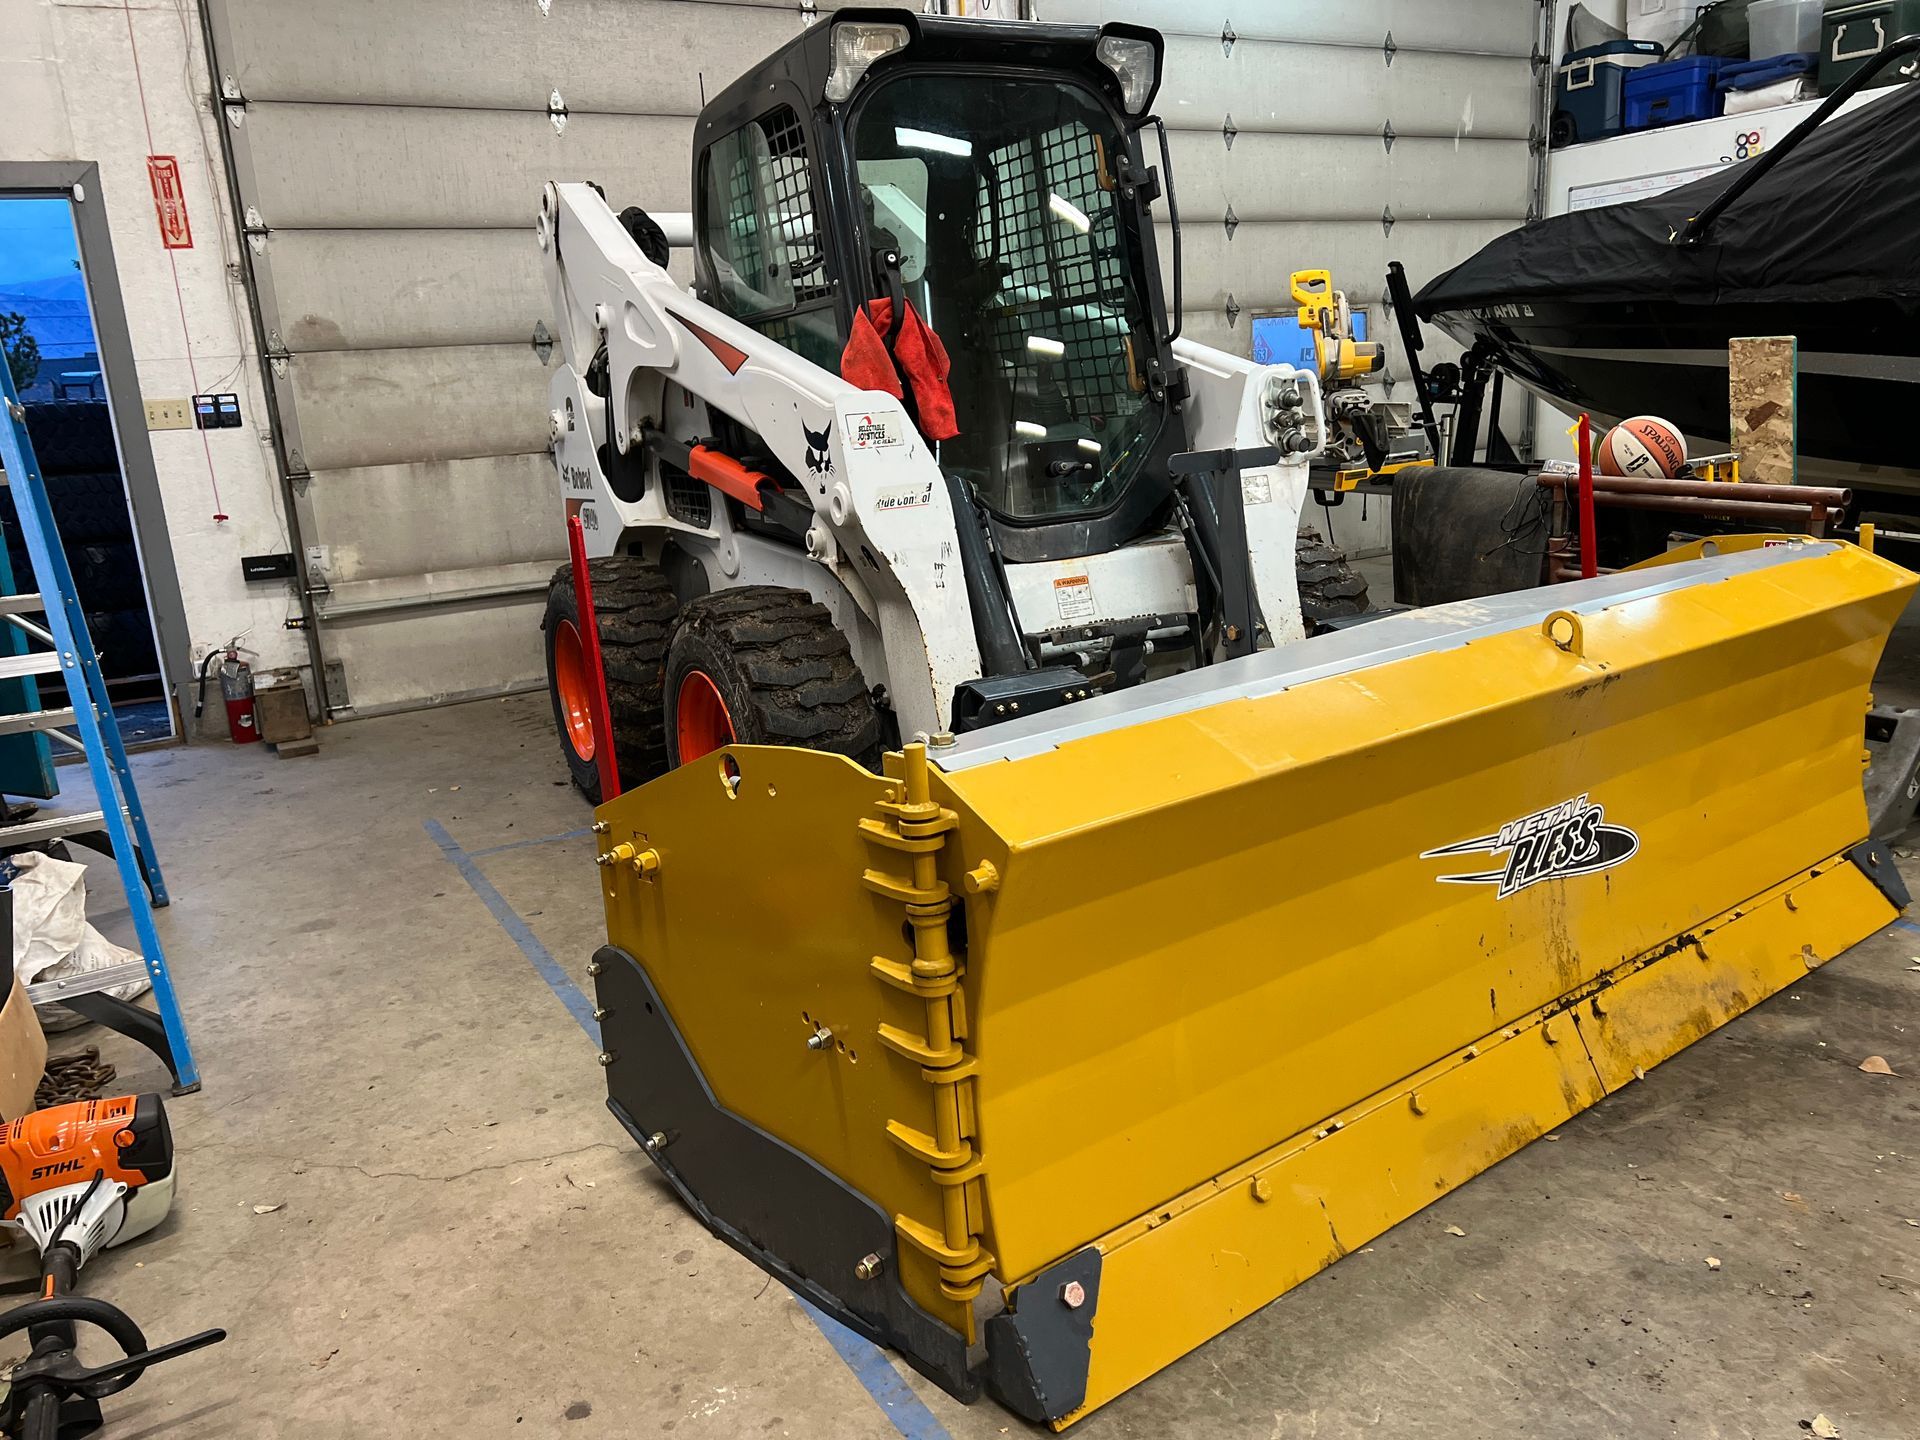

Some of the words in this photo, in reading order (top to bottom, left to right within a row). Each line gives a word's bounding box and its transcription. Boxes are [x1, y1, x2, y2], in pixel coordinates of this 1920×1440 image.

[156, 169, 172, 178] FIRE
[1639, 425, 1680, 471] SPALDING
[1062, 577, 1086, 585] WARNING
[1495, 792, 1588, 847] METAL
[1502, 807, 1601, 891] PLESS
[31, 1159, 84, 1180] STIHL
